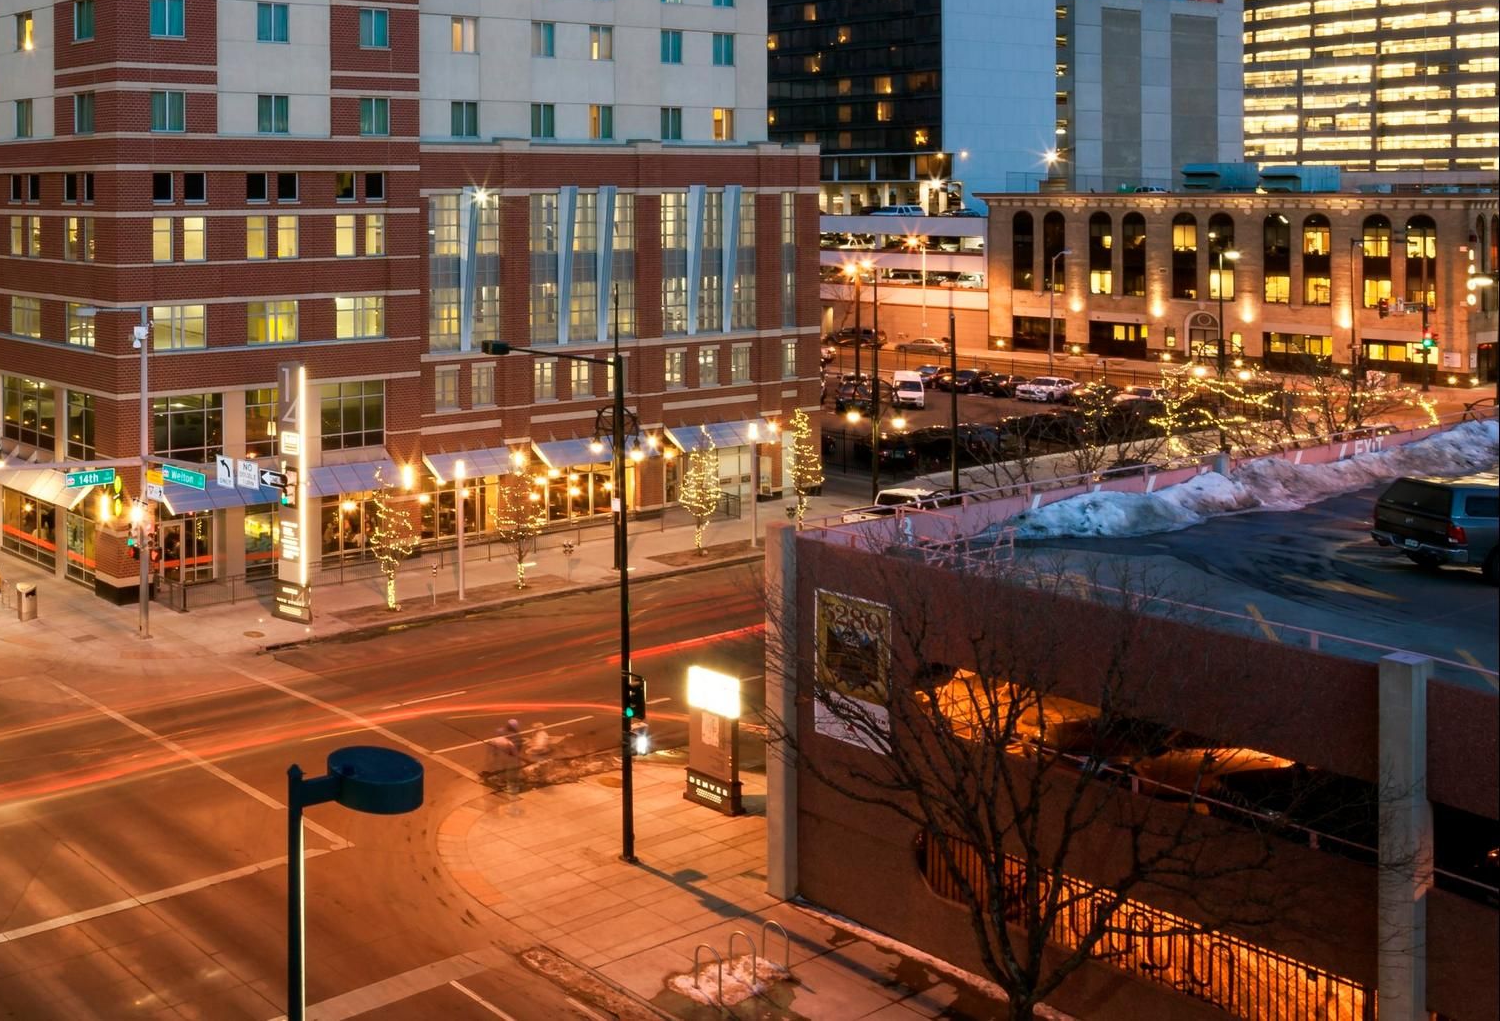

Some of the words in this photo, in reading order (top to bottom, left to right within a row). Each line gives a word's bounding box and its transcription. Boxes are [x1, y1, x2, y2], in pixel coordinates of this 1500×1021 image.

[1354, 436, 1385, 456] EXIT
[242, 462, 253, 472] NO
[78, 473, 99, 485] 14th
[171, 470, 195, 485] Welton
[689, 775, 728, 797] DENVER
